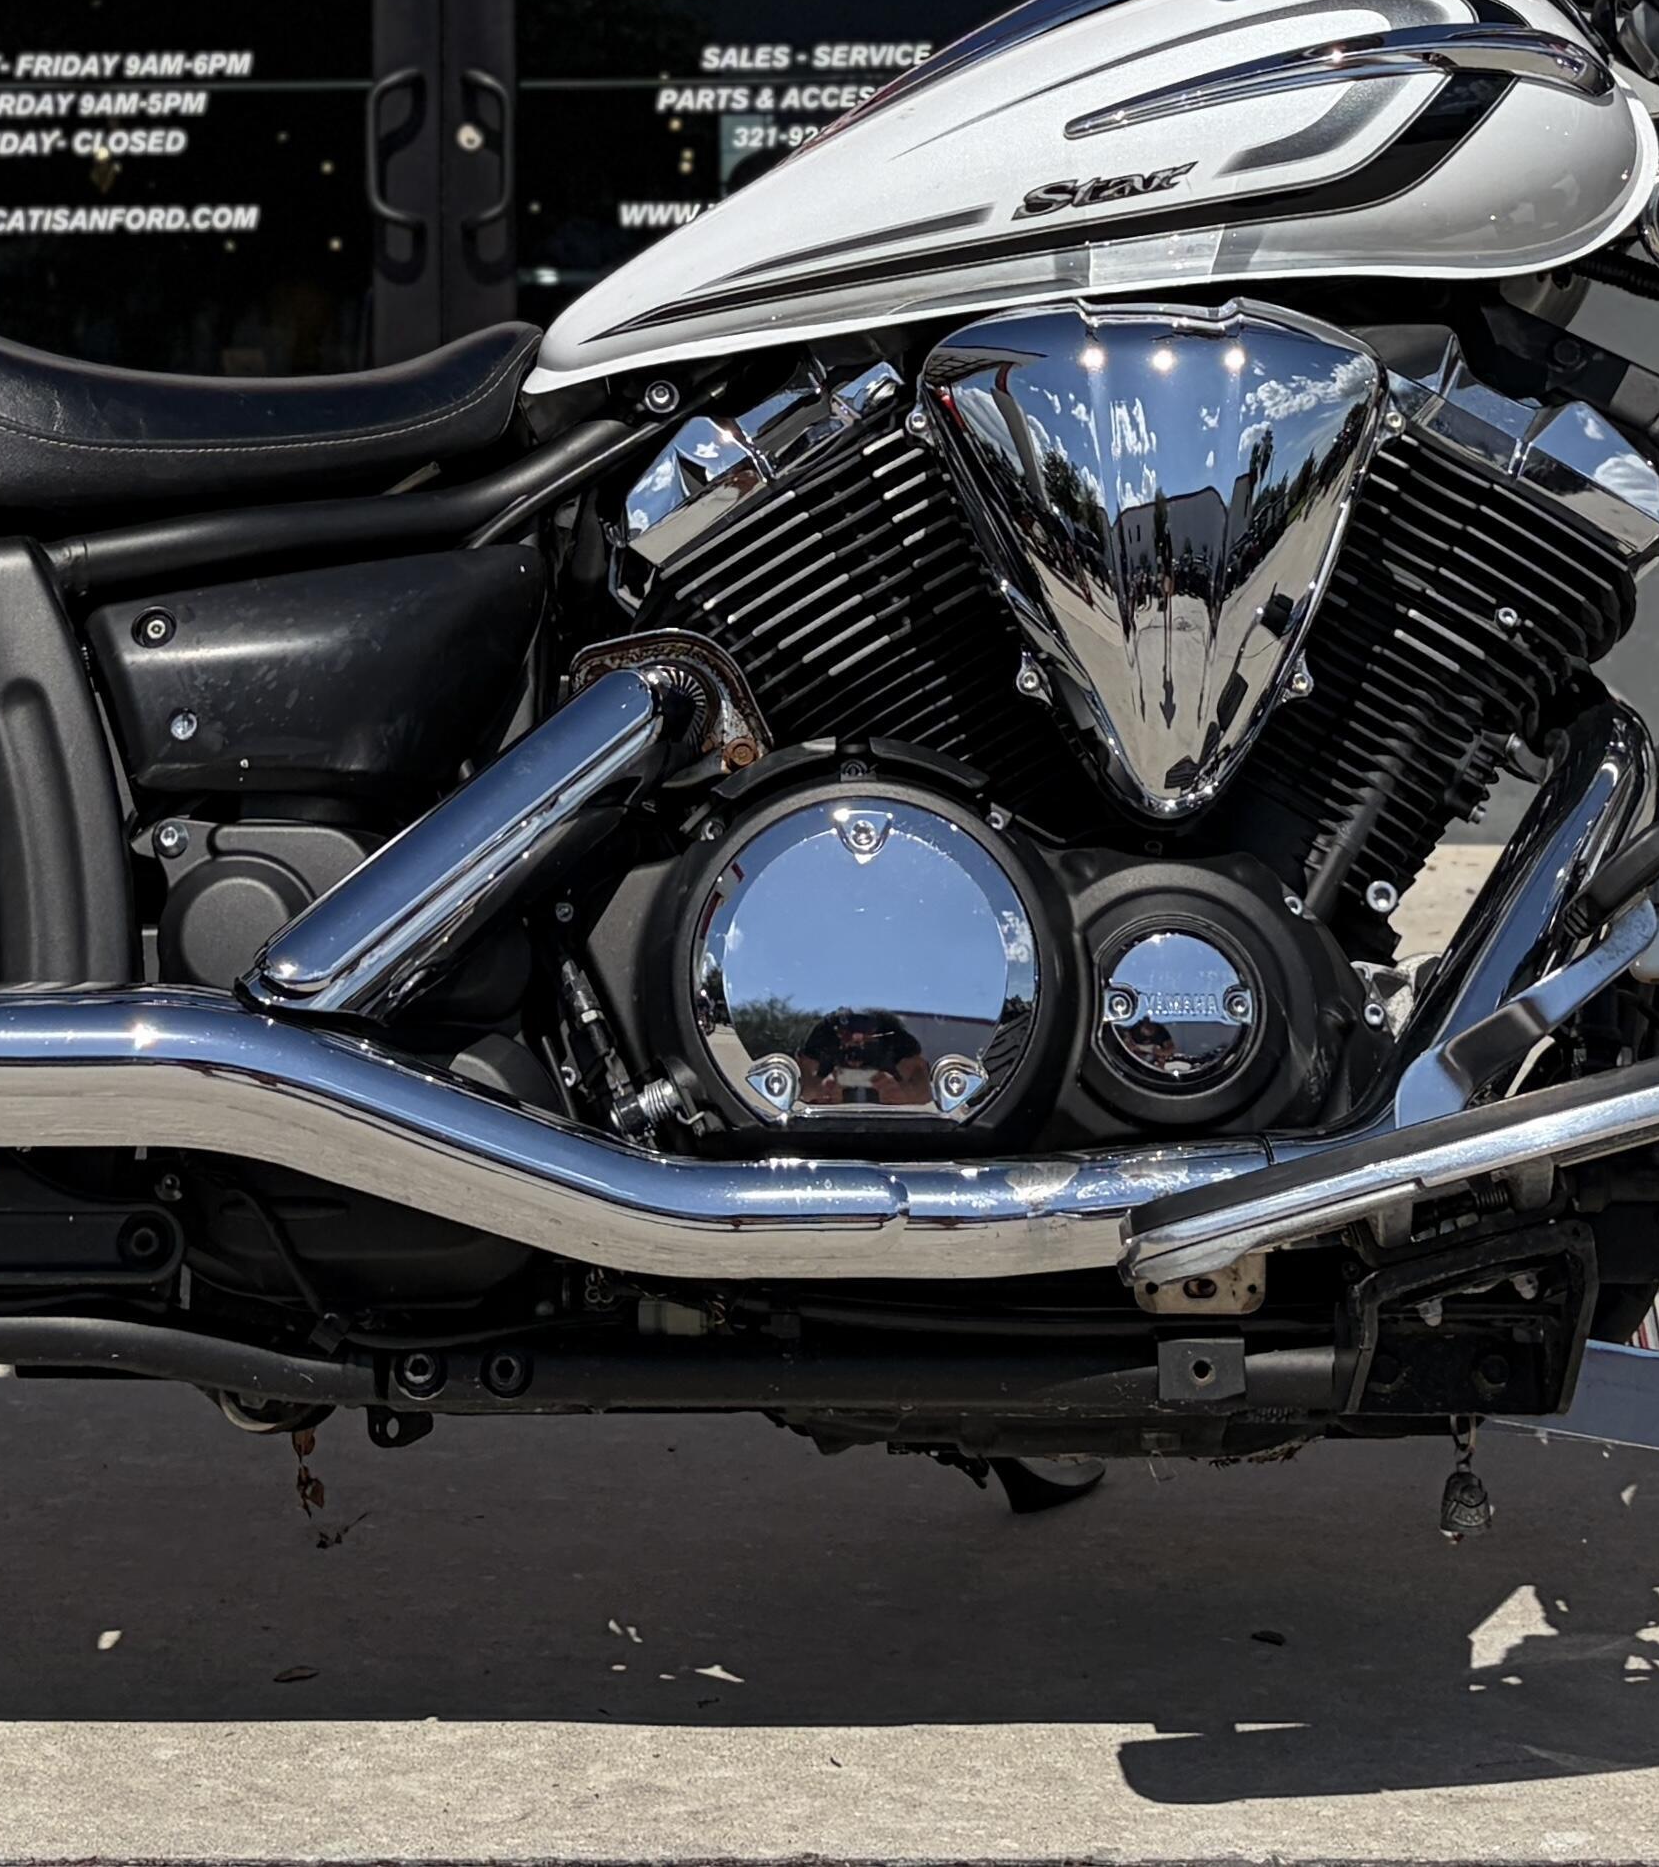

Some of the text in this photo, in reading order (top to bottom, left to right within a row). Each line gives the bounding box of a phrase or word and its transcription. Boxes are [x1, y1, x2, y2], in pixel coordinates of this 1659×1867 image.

[14, 53, 122, 78] FRIDAY
[124, 52, 254, 76] 9AM-6PM
[700, 46, 790, 70] SALES
[812, 44, 932, 68] SERVICE
[78, 92, 208, 115] 9AM-5PM
[655, 86, 885, 112] PARTS & ACCES
[71, 129, 187, 154] CLOSED
[731, 125, 826, 147] 321-92
[1011, 161, 1199, 221] Star
[620, 202, 715, 226] WWW
[1143, 993, 1220, 1016] YAMAHA
